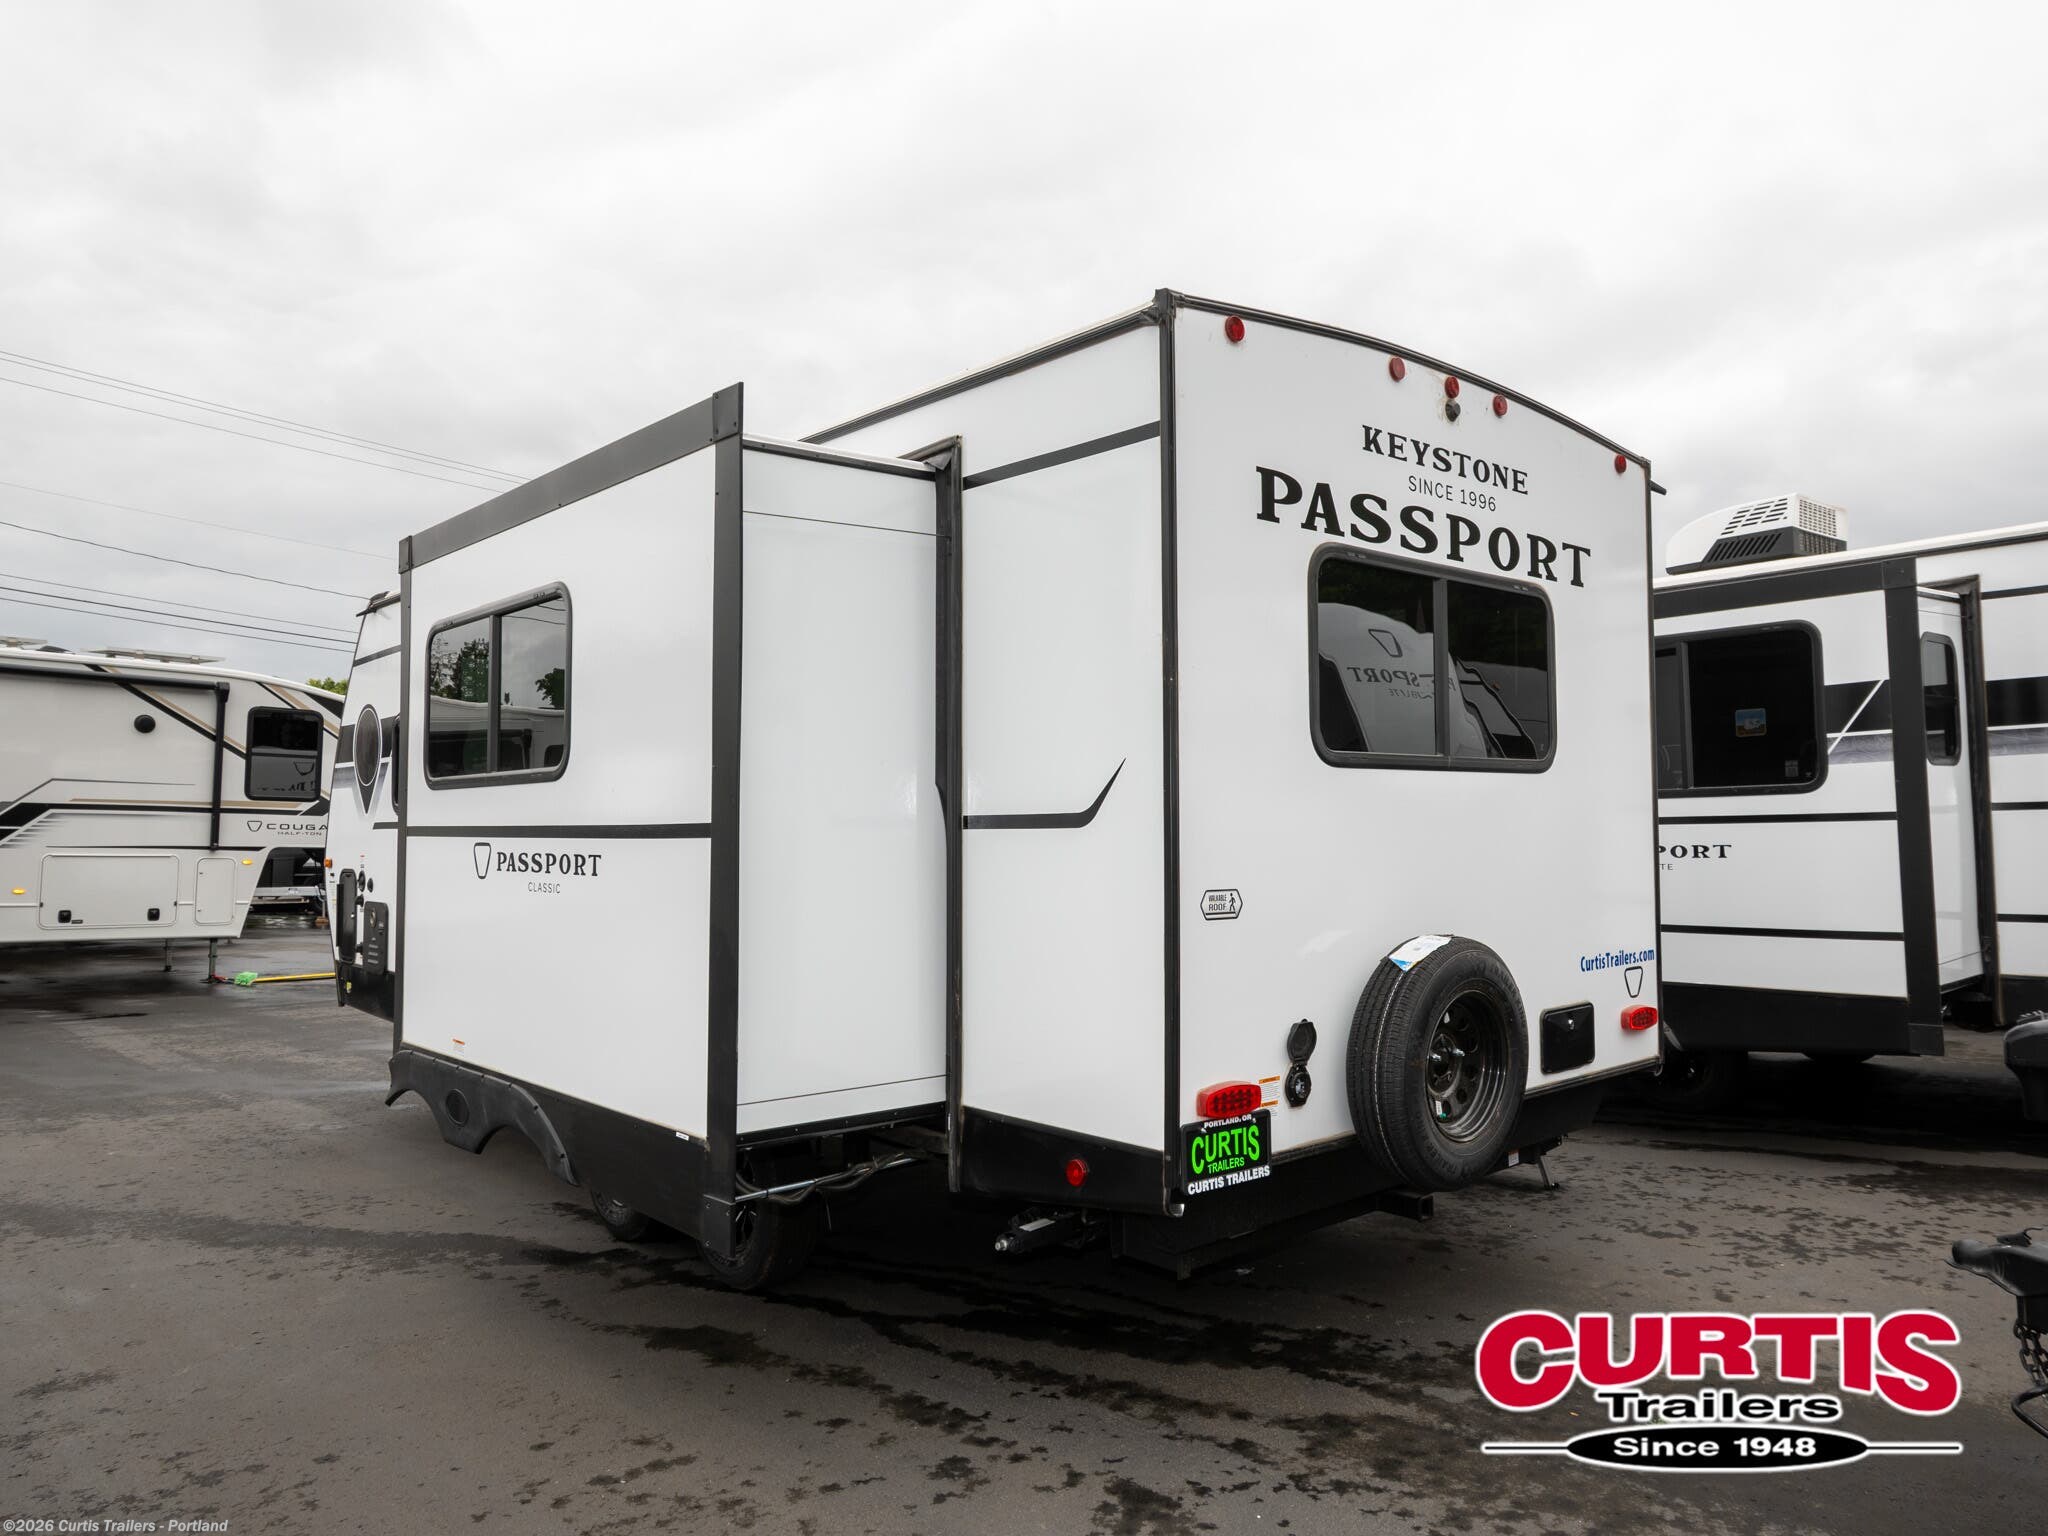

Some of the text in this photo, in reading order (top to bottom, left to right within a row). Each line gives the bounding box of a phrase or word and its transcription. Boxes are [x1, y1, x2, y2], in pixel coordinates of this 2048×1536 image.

[1361, 424, 1529, 495] KEYSTONE
[1408, 475, 1497, 512] SINCE 1996
[1255, 465, 1592, 588] PASSPORT
[496, 851, 602, 877] PASSPORT
[527, 881, 561, 894] CLASSIC
[1208, 903, 1227, 911] ROOF
[1580, 949, 1655, 972] CurtisTrailers.com
[1204, 1114, 1252, 1129] PORTLAND, OR
[1191, 1125, 1260, 1174] CURTIS
[1207, 1157, 1245, 1174] TRAILERS
[1187, 1165, 1271, 1195] CURTIS TRAILERS
